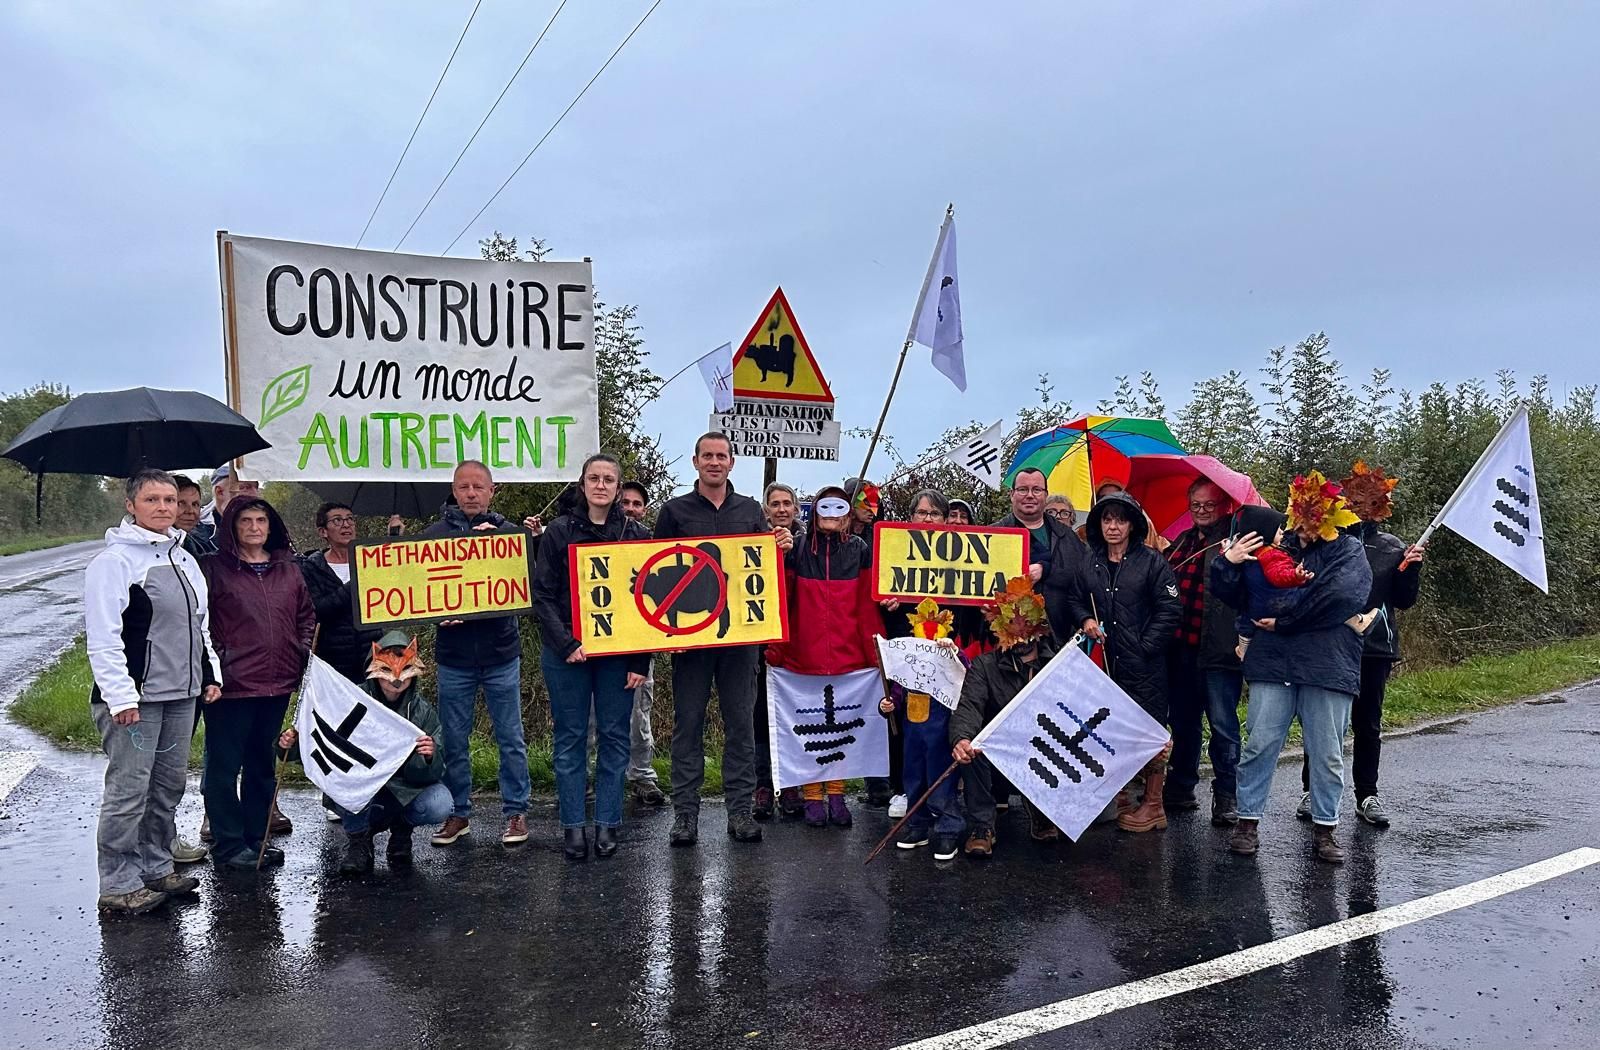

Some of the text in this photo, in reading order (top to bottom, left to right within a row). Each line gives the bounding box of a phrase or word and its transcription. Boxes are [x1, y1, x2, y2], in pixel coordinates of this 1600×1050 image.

[328, 356, 542, 401] un monde
[784, 419, 824, 436] NON!
[297, 411, 579, 470] AUTREMENT
[744, 431, 780, 444] BOIS
[743, 445, 836, 460] GUERIVIERE
[906, 530, 993, 565] NON
[890, 566, 1008, 597] METHA
[889, 640, 906, 651] DES
[914, 681, 925, 690] DE
